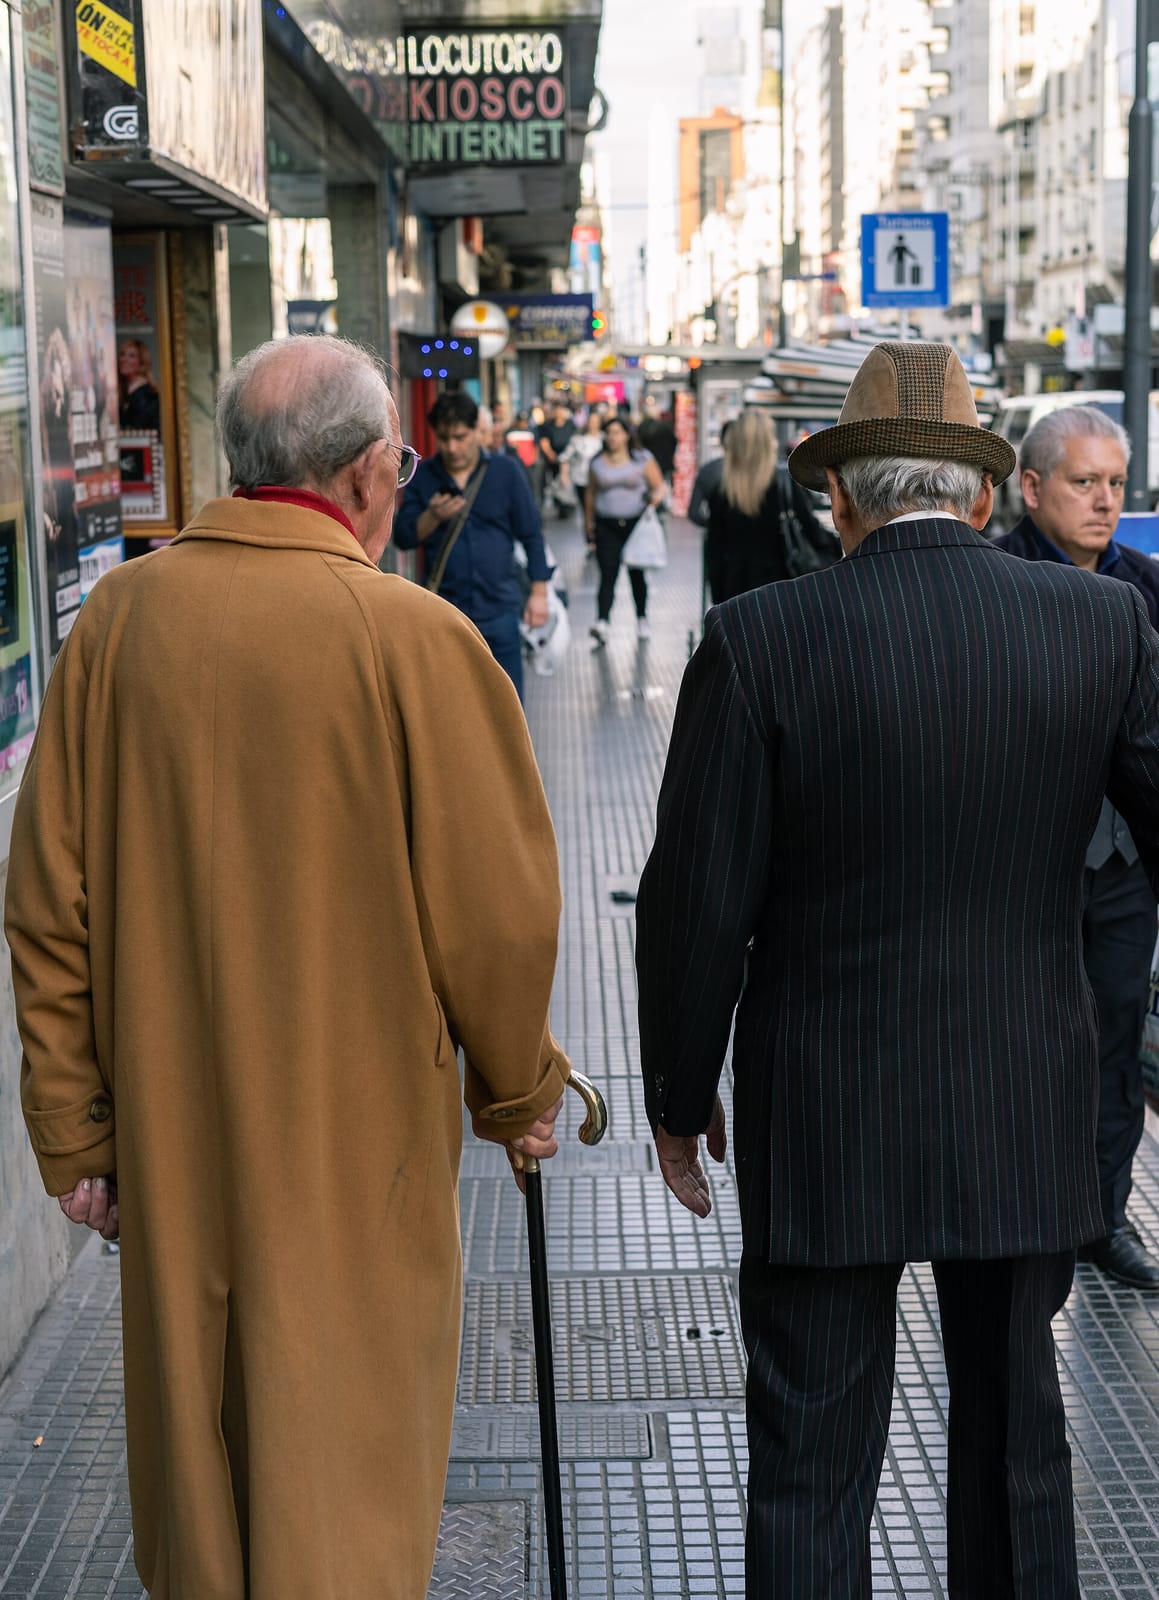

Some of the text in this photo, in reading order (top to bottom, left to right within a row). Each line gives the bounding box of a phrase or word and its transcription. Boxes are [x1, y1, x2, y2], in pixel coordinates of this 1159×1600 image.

[92, 35, 120, 60] TOCA
[103, 30, 114, 42] YA
[115, 37, 127, 50] LA
[407, 33, 562, 75] LOCUTORIO
[409, 77, 565, 120] KIOSCO
[411, 121, 565, 162] INTERNET
